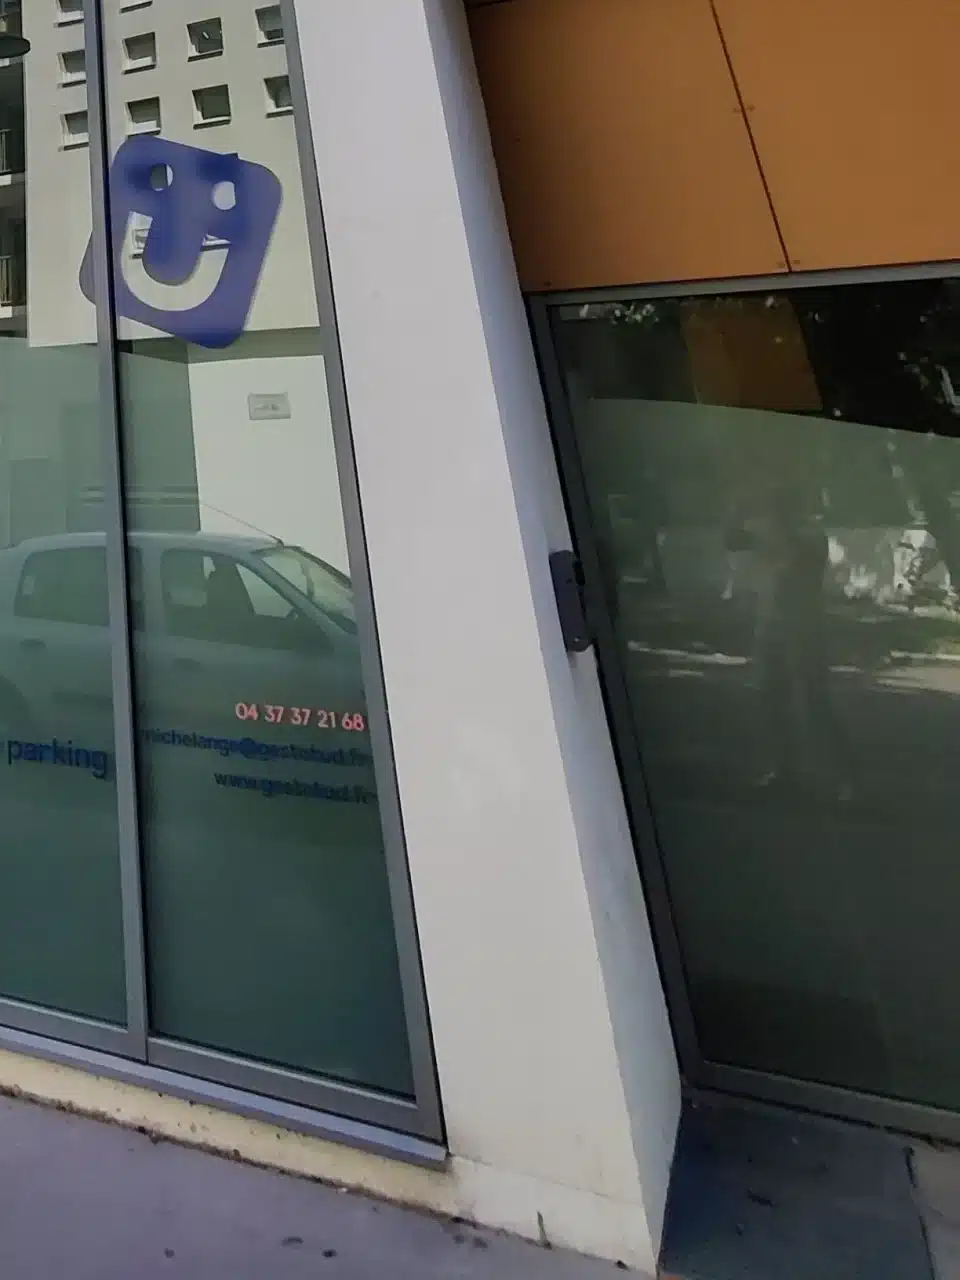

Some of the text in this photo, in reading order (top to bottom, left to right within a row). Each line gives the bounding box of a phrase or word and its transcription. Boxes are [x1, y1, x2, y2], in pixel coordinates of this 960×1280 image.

[235, 702, 365, 732] 04 37 37 21 68
[6, 735, 108, 780] parking
